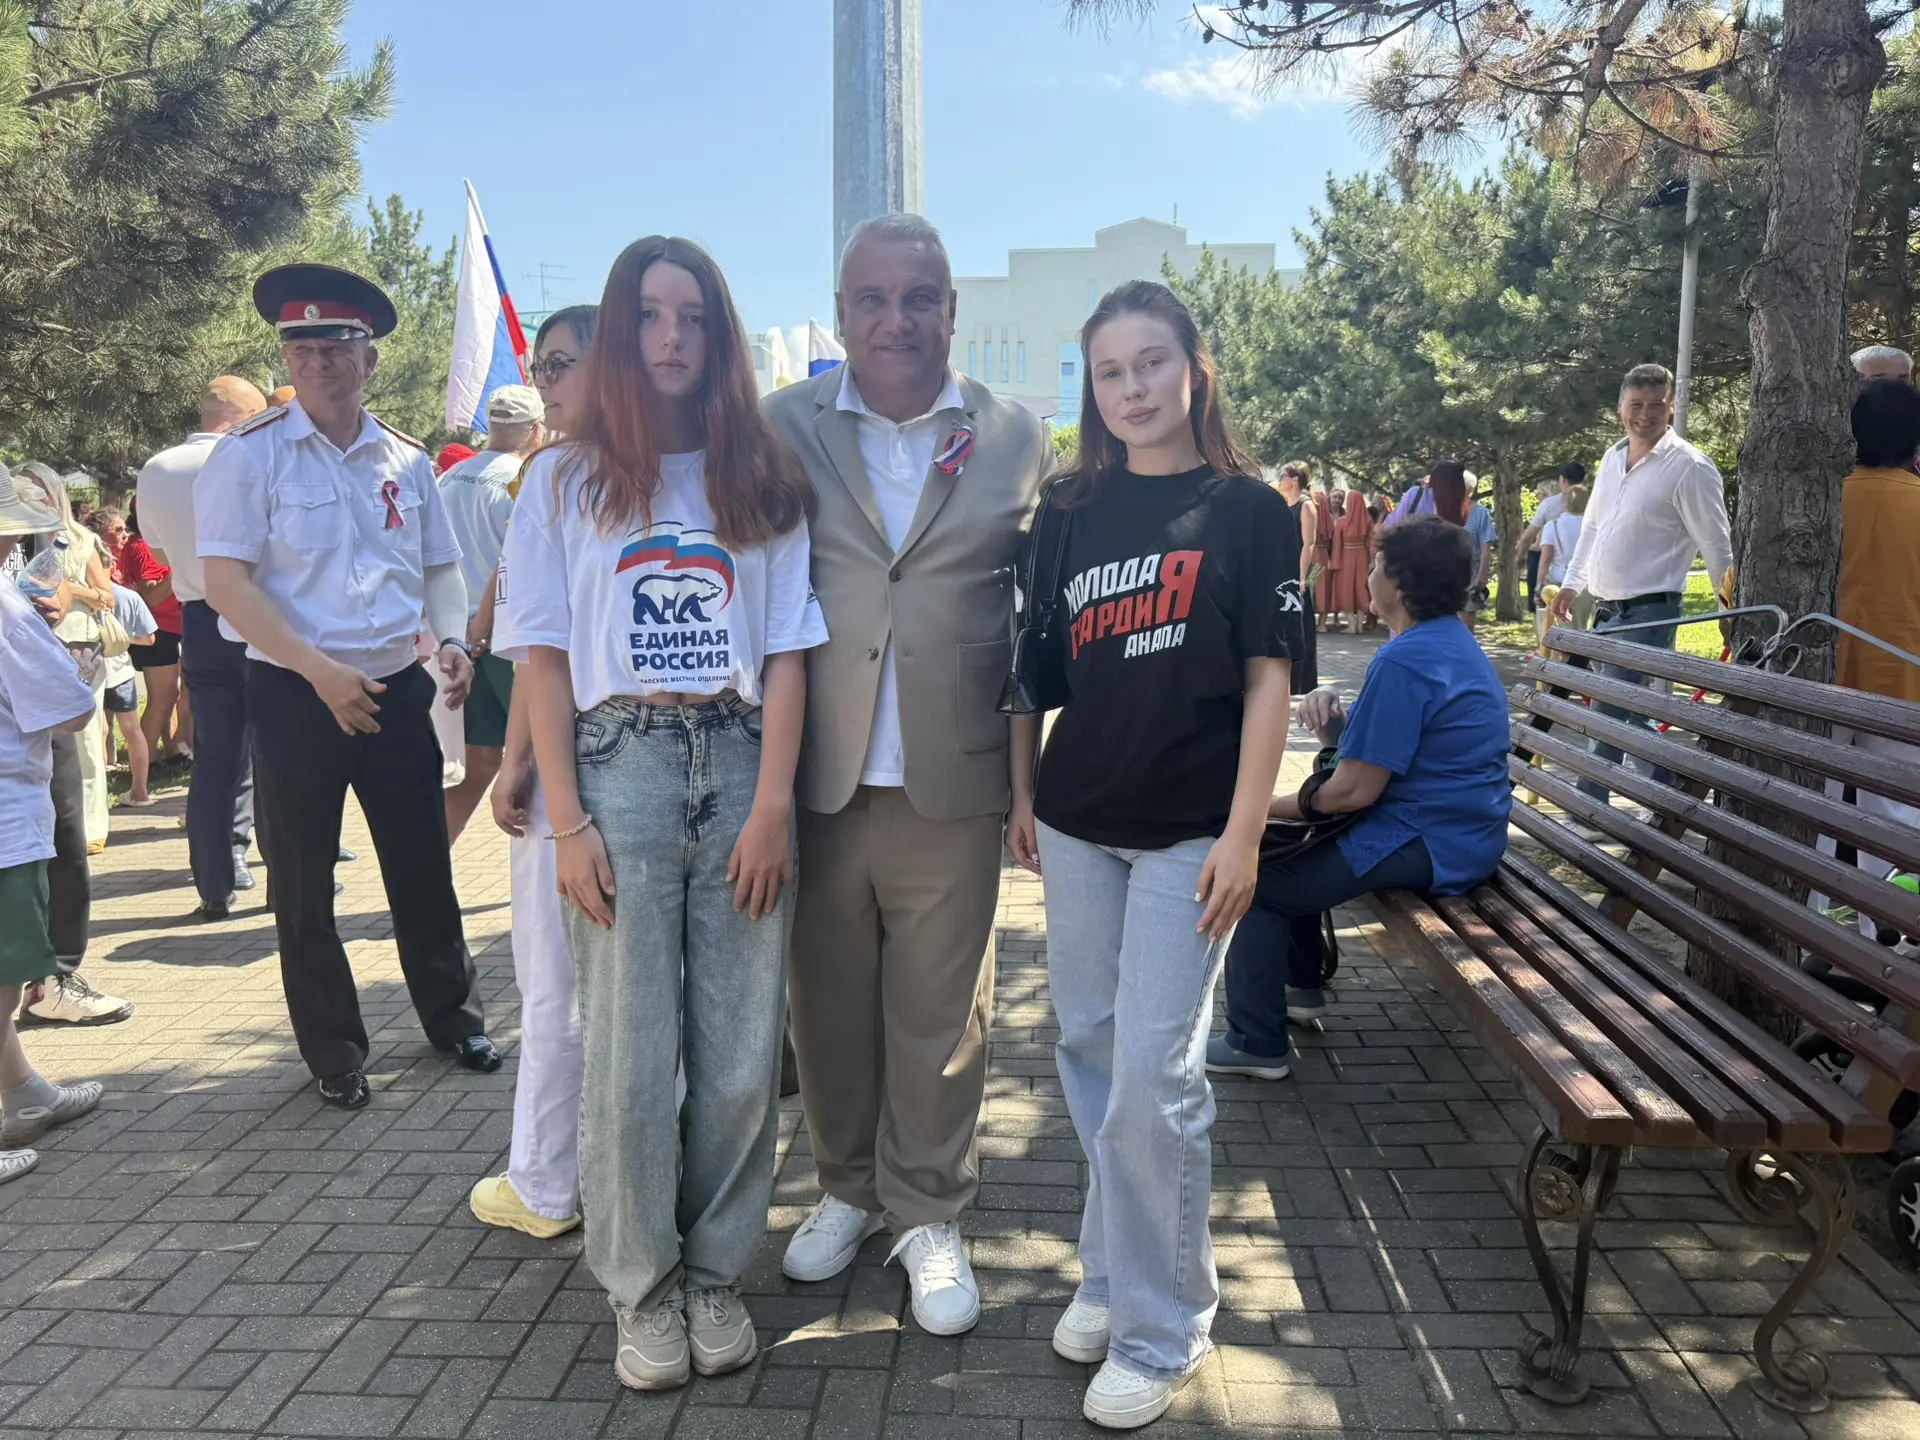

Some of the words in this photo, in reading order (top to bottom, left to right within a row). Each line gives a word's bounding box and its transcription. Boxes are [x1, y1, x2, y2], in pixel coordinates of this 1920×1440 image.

[630, 629, 729, 650] ЕДИНАЯ
[1124, 623, 1186, 658] АНАПА
[632, 651, 729, 671] РОССИЯ
